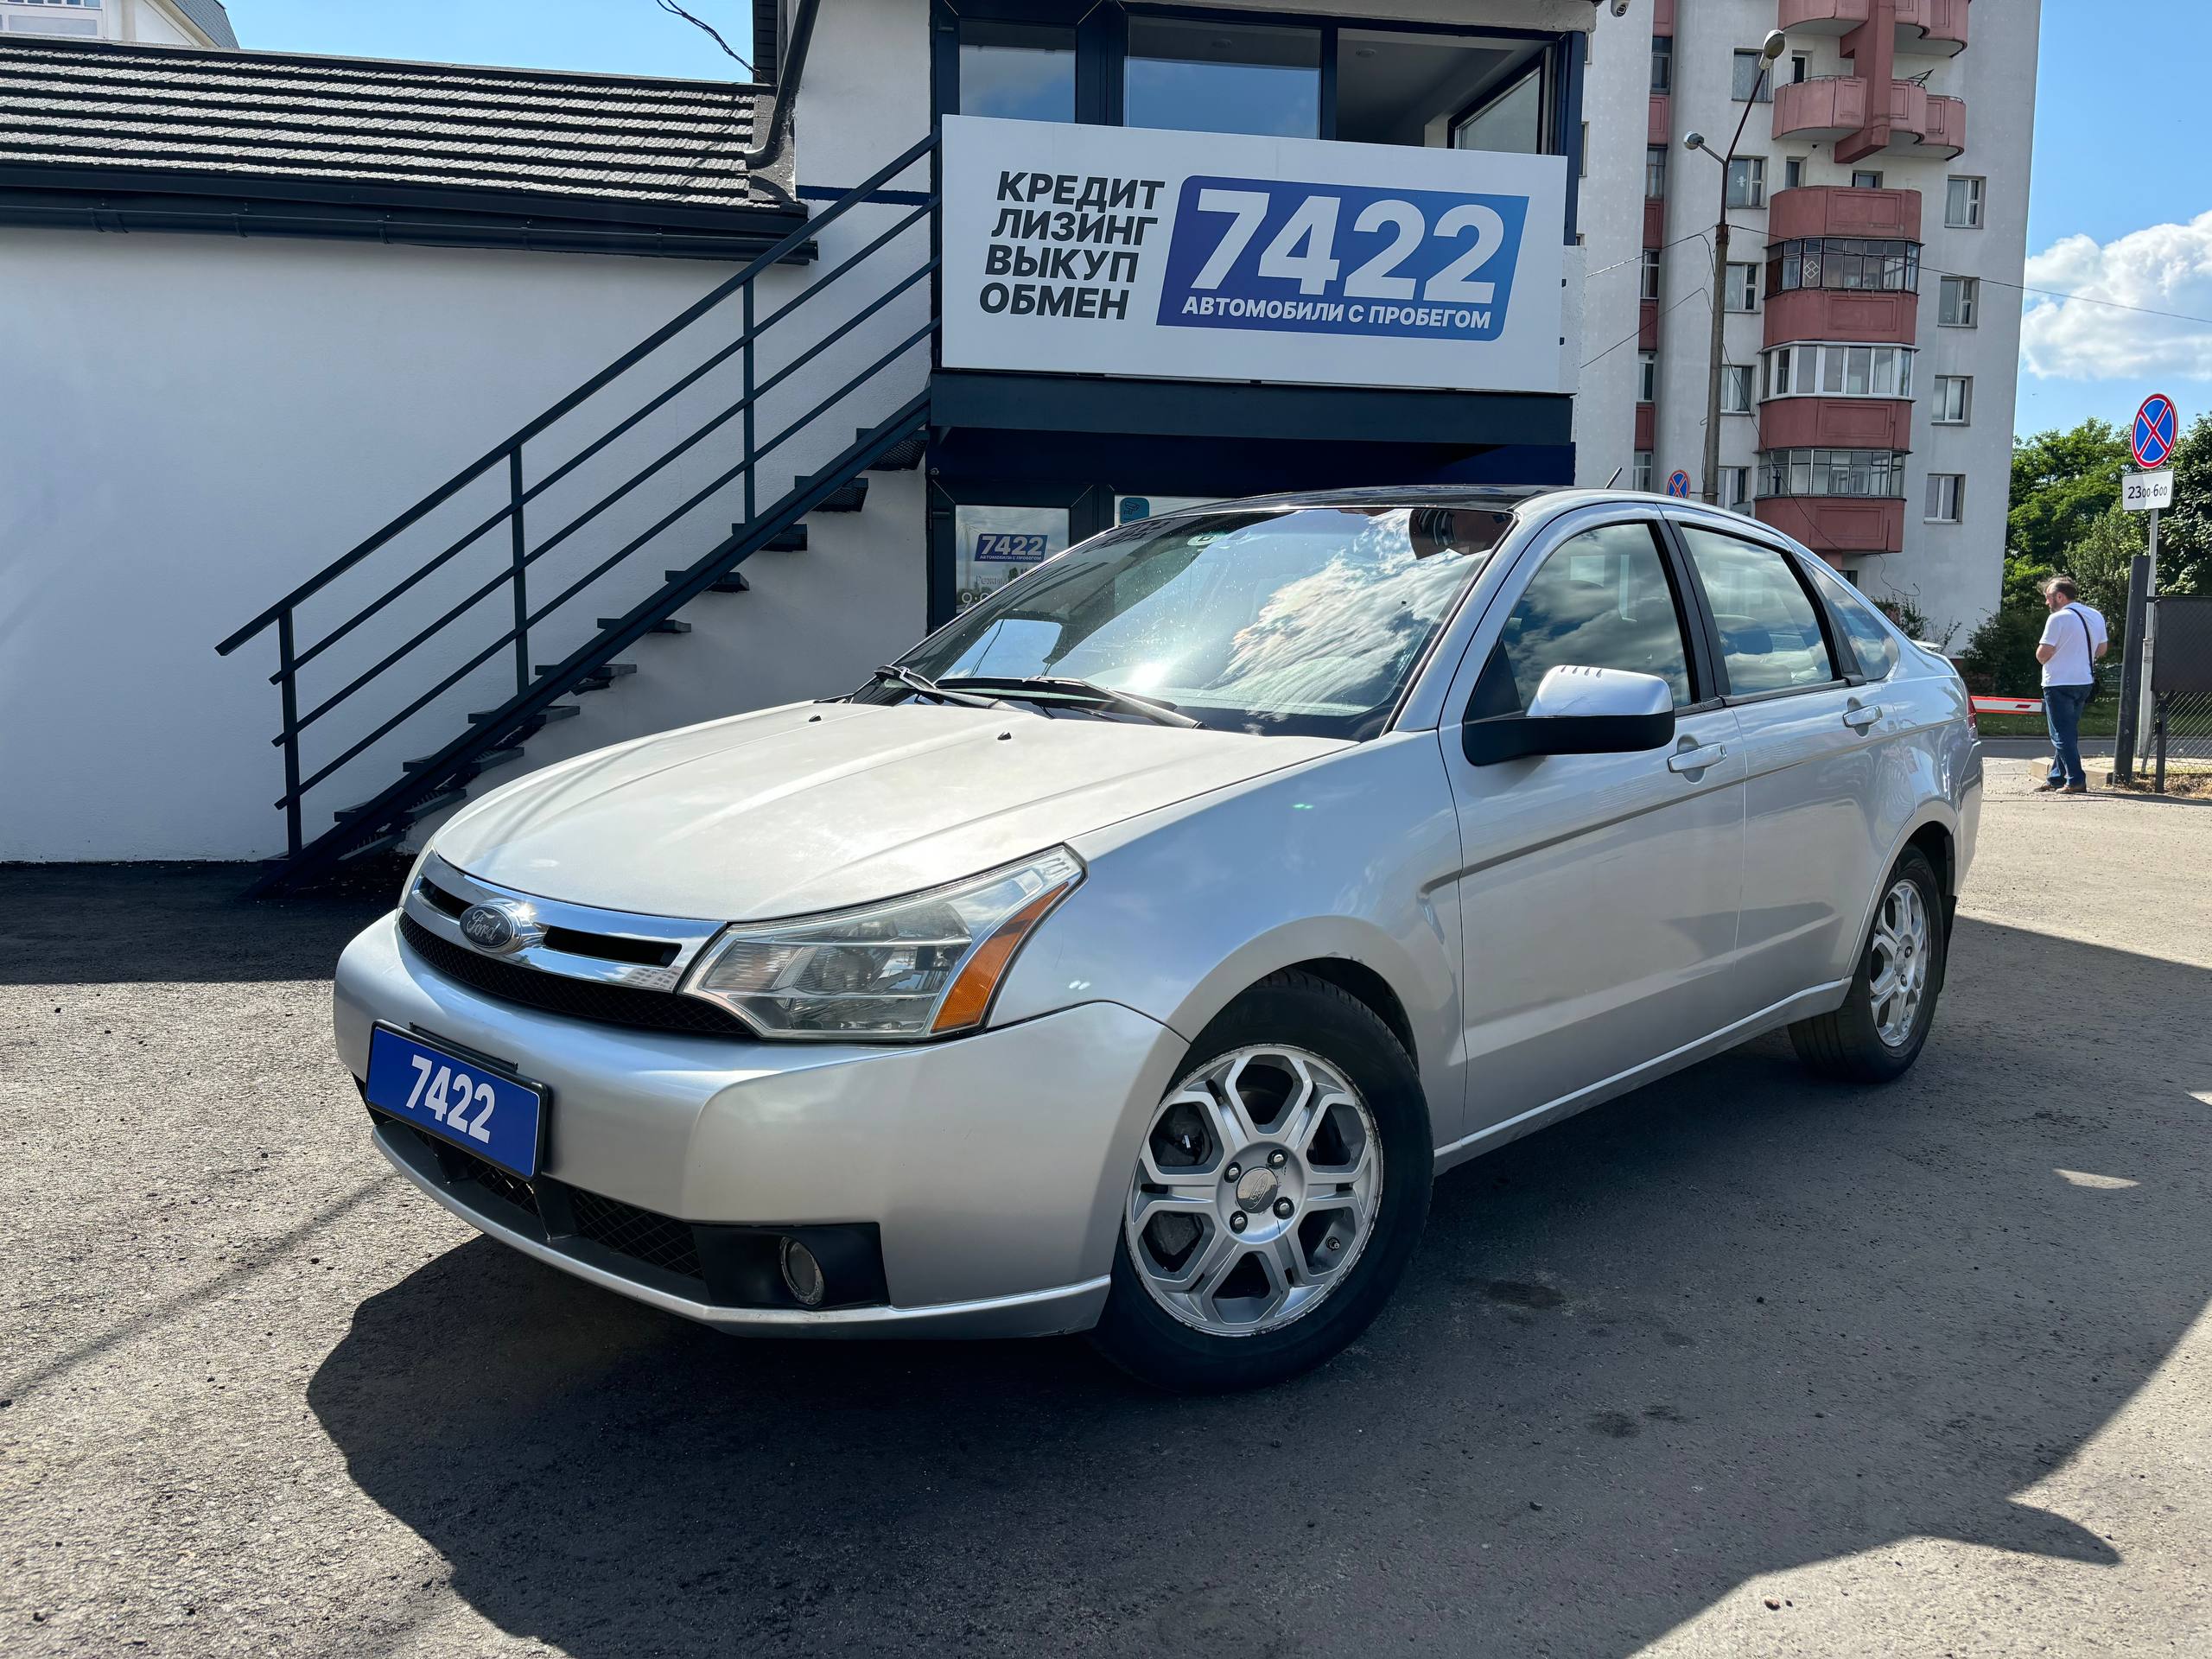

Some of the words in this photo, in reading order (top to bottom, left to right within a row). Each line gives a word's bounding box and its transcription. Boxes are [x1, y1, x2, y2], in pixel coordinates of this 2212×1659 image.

[996, 170, 1166, 213] КРЕДИТ
[991, 208, 1158, 246] ЛИЗИНГ
[1191, 188, 1505, 304] 7422
[985, 245, 1140, 283] ВЫКУП
[979, 283, 1130, 321] ОБМЕН
[1181, 296, 1344, 323] АВТОМОБИЛИ
[1348, 302, 1363, 324] С
[1368, 304, 1491, 328] ПРОБЕГОМ
[982, 535, 1044, 556] 7422
[467, 910, 502, 941] Ford
[405, 1054, 496, 1144] 7422
